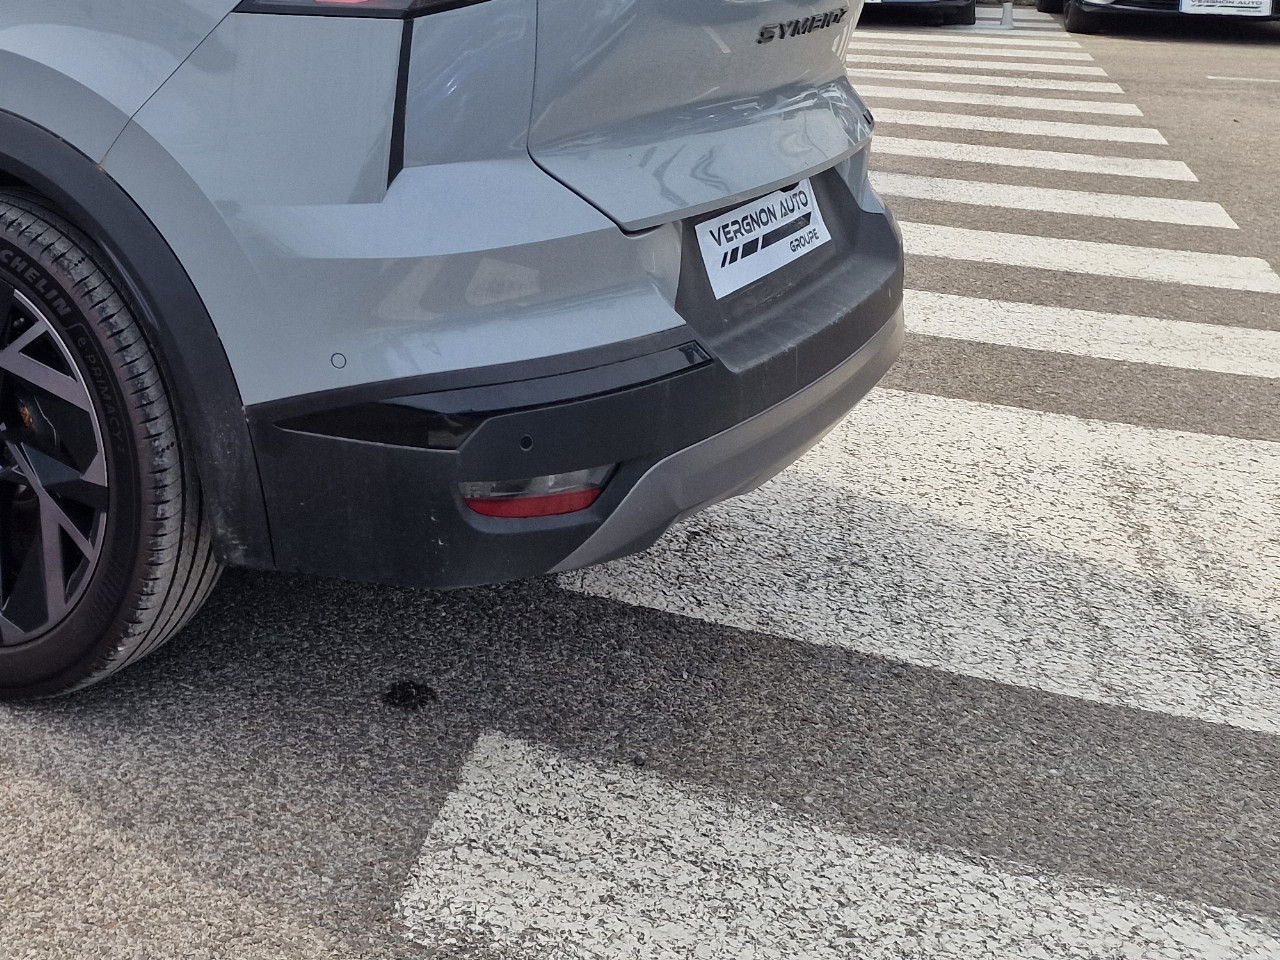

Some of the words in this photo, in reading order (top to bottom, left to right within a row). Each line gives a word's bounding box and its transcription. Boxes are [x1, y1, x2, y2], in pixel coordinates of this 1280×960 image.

[708, 208, 778, 247] VERGNON
[779, 190, 809, 219] AUTO
[789, 228, 820, 253] GROUPE
